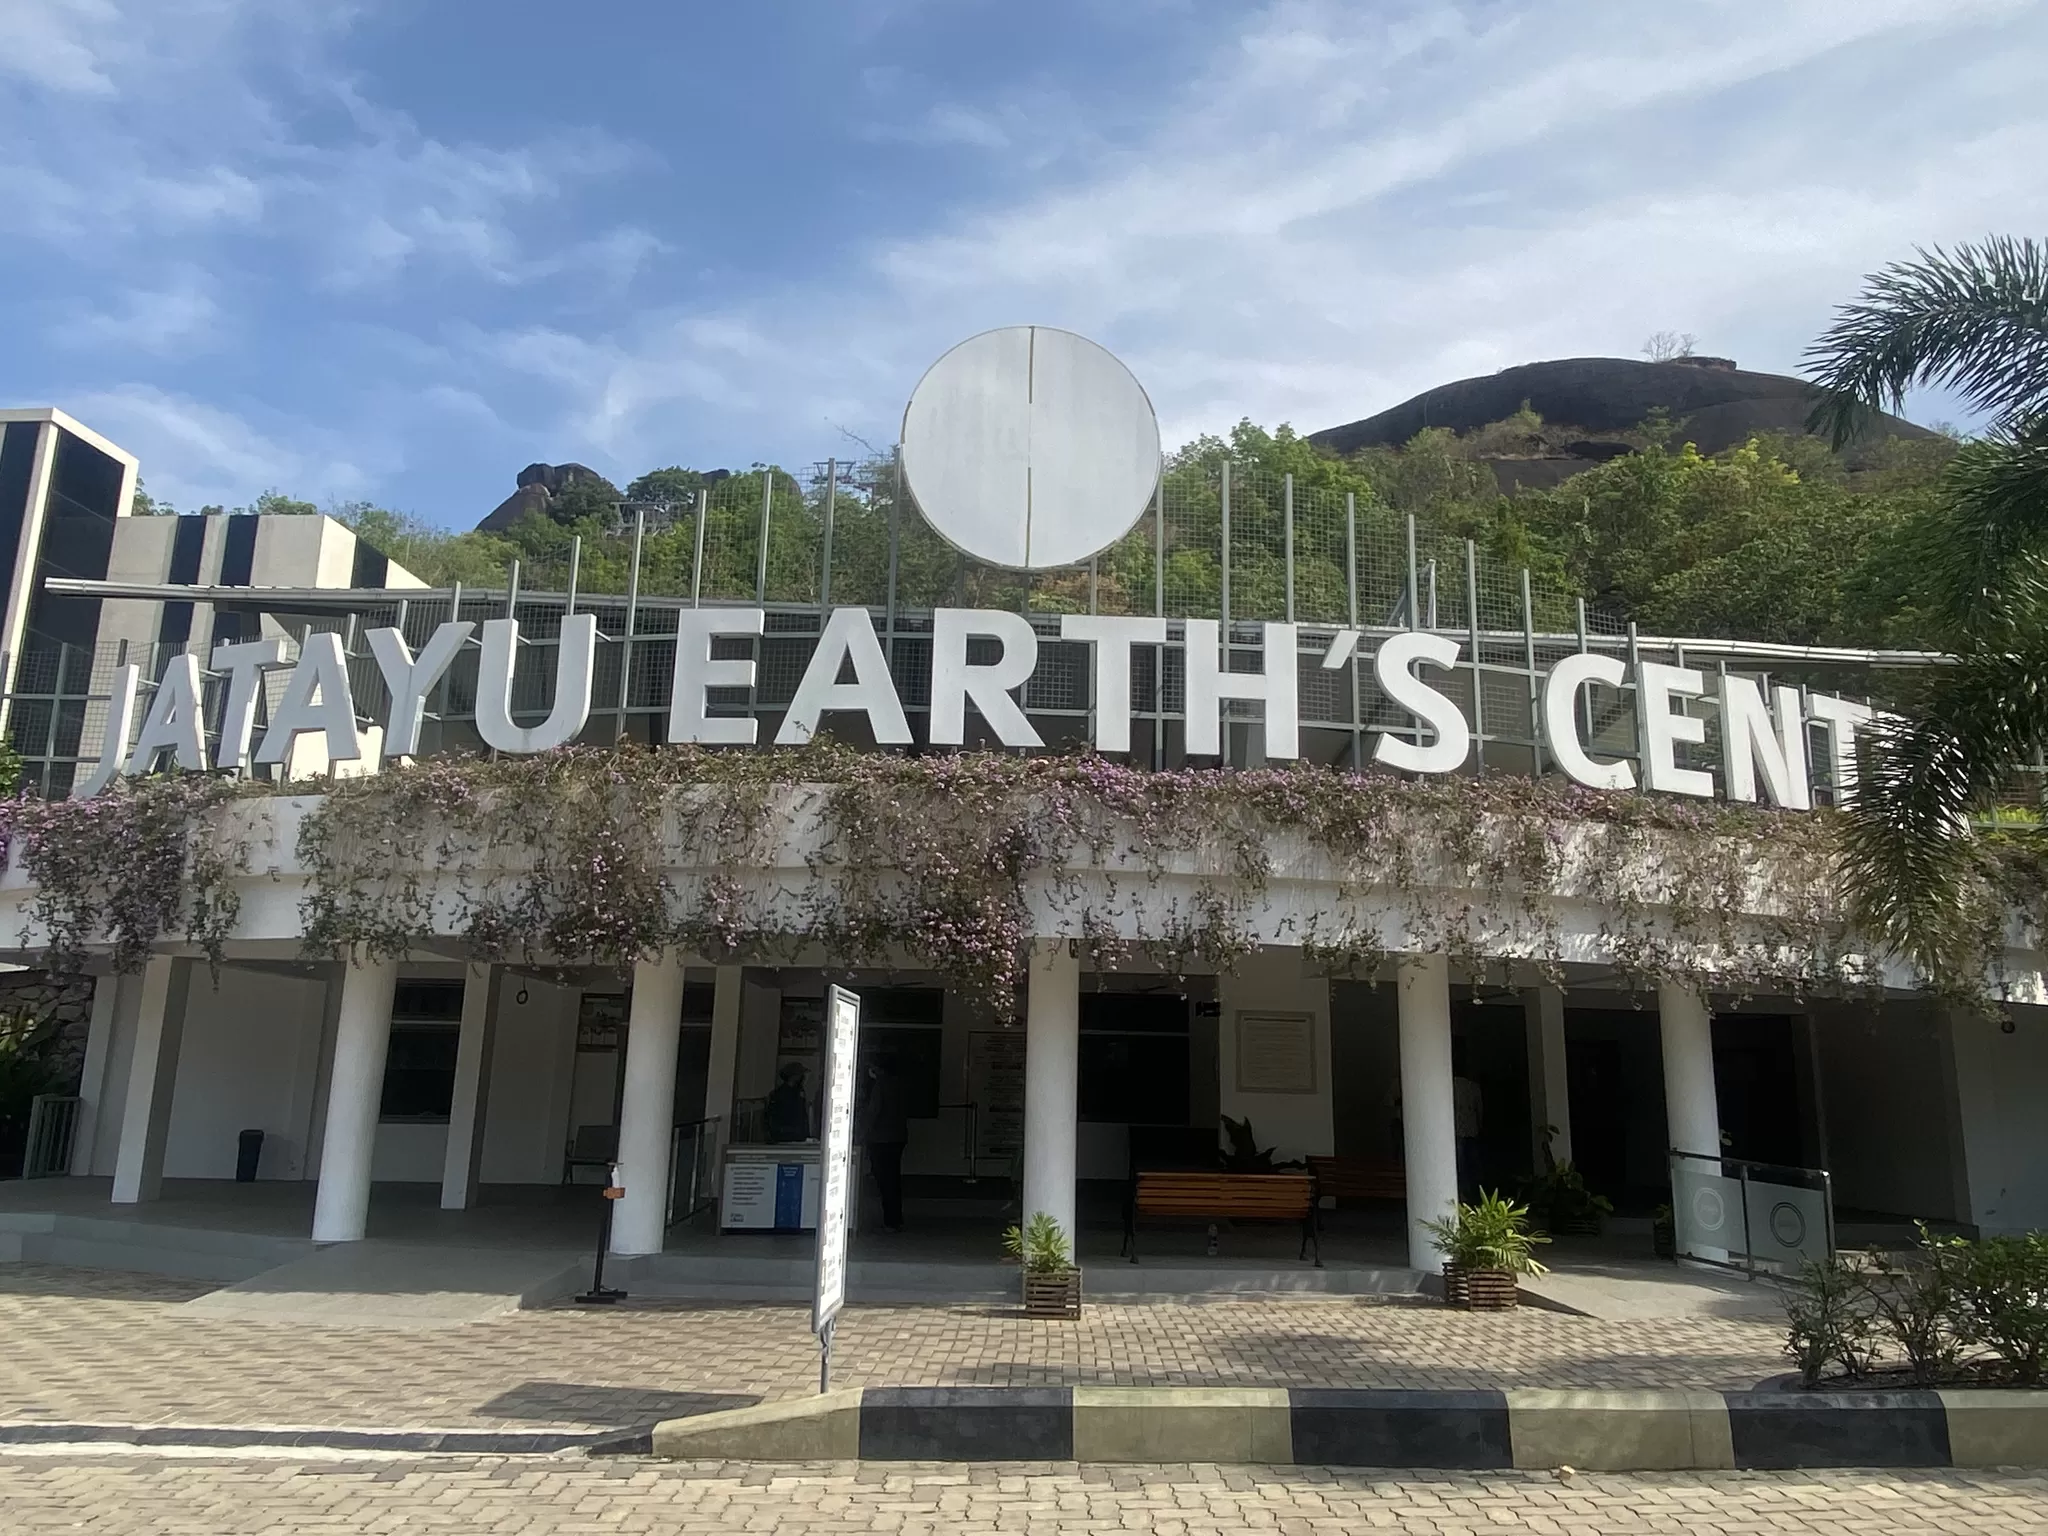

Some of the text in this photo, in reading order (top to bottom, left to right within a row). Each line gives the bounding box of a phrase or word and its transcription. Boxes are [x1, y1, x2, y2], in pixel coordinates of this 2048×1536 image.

[73, 607, 1968, 838] JATAYU EARTH'S CENT
